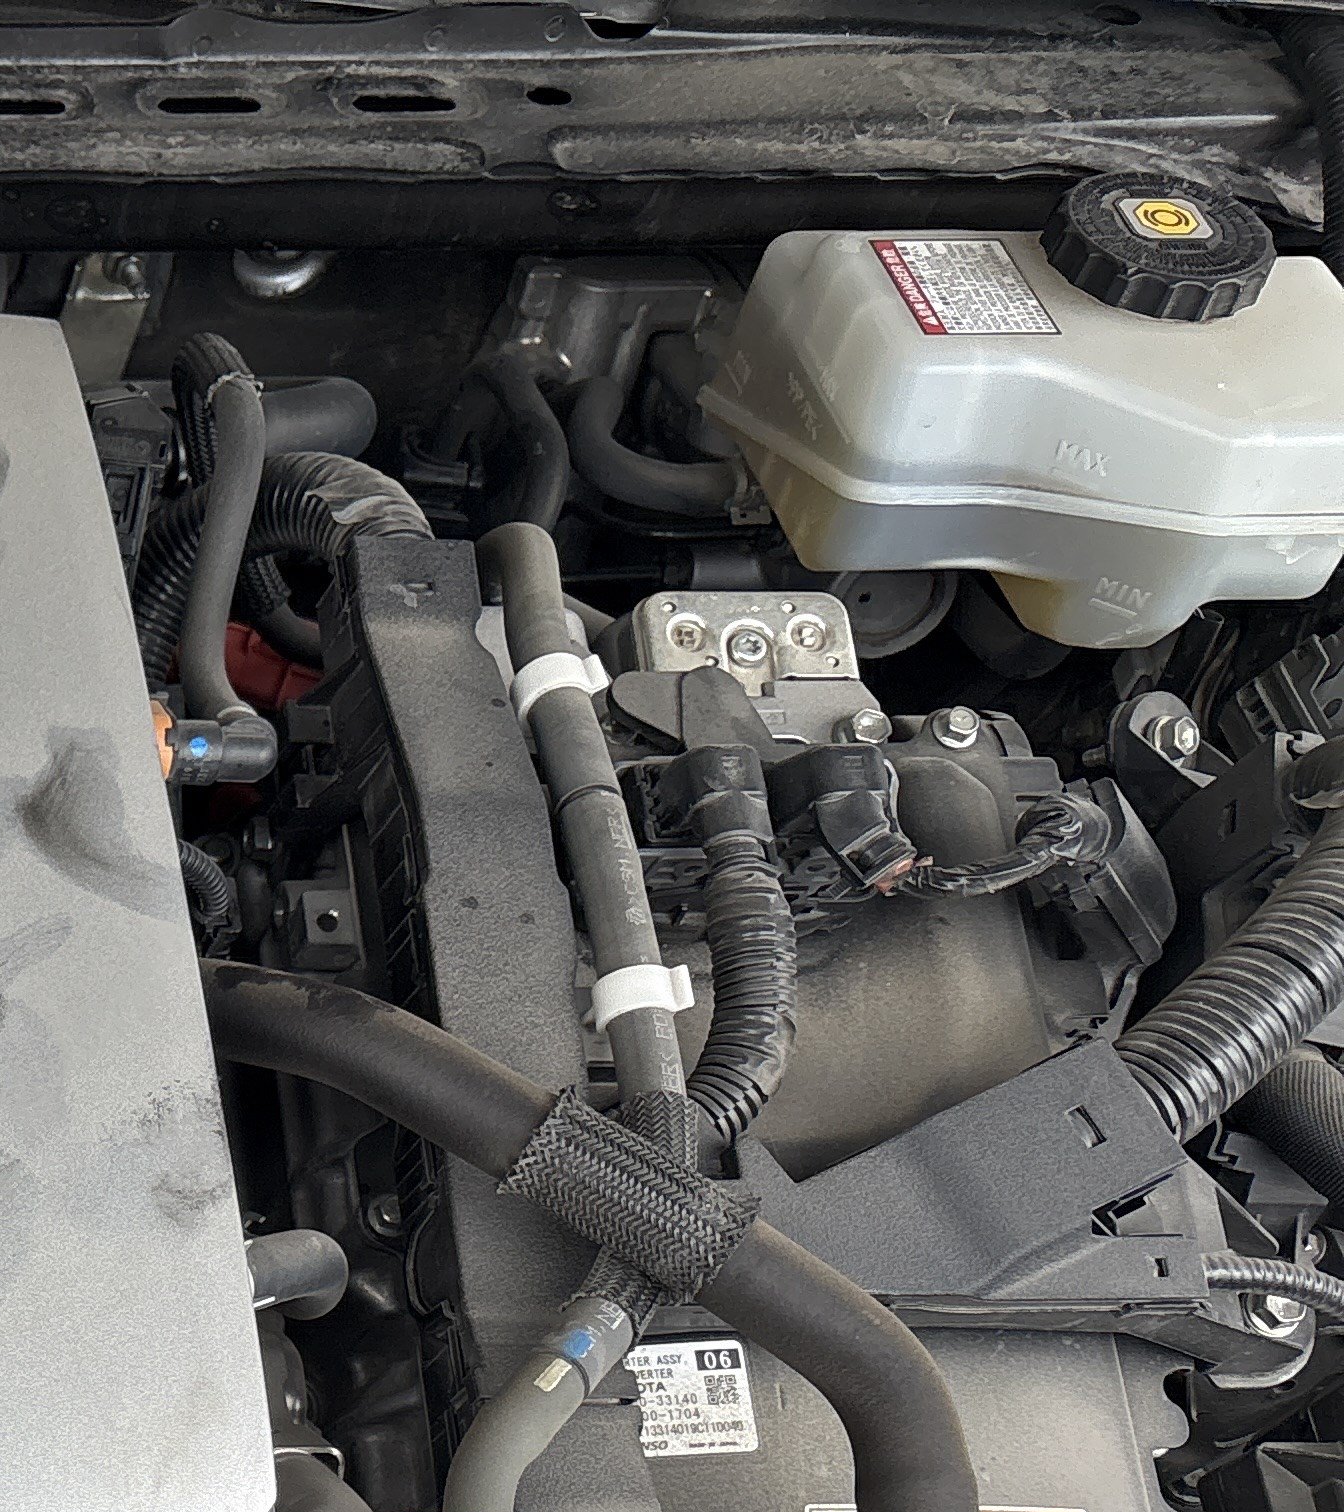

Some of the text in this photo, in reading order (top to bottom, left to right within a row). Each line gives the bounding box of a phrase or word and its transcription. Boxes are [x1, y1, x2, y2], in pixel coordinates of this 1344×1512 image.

[892, 263, 925, 302] DANGER
[1054, 437, 1111, 477] MAX
[1094, 577, 1152, 609] MIN
[703, 1350, 732, 1370] 06
